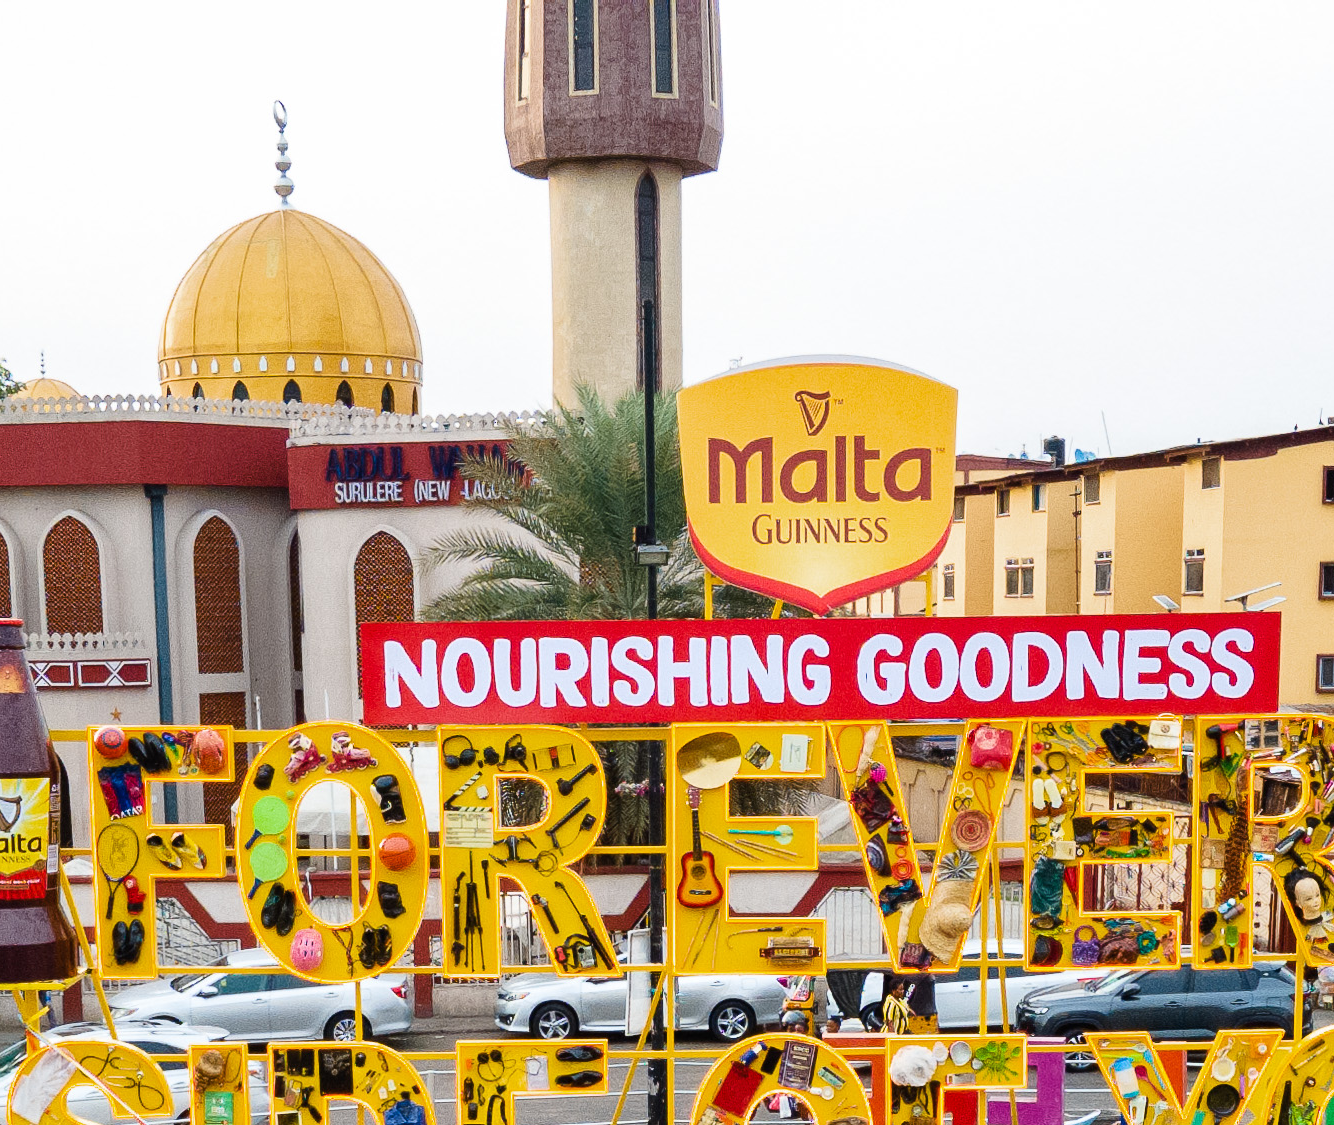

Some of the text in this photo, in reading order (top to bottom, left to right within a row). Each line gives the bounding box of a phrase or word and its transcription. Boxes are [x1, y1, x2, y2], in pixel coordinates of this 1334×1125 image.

[327, 446, 410, 482] ABDUL
[708, 435, 932, 503] Malta
[335, 481, 403, 504] SURULERE
[752, 513, 889, 545] GUINNESS
[384, 627, 1256, 710] NOURISHING GOODNESS
[87, 721, 622, 982] FOR
